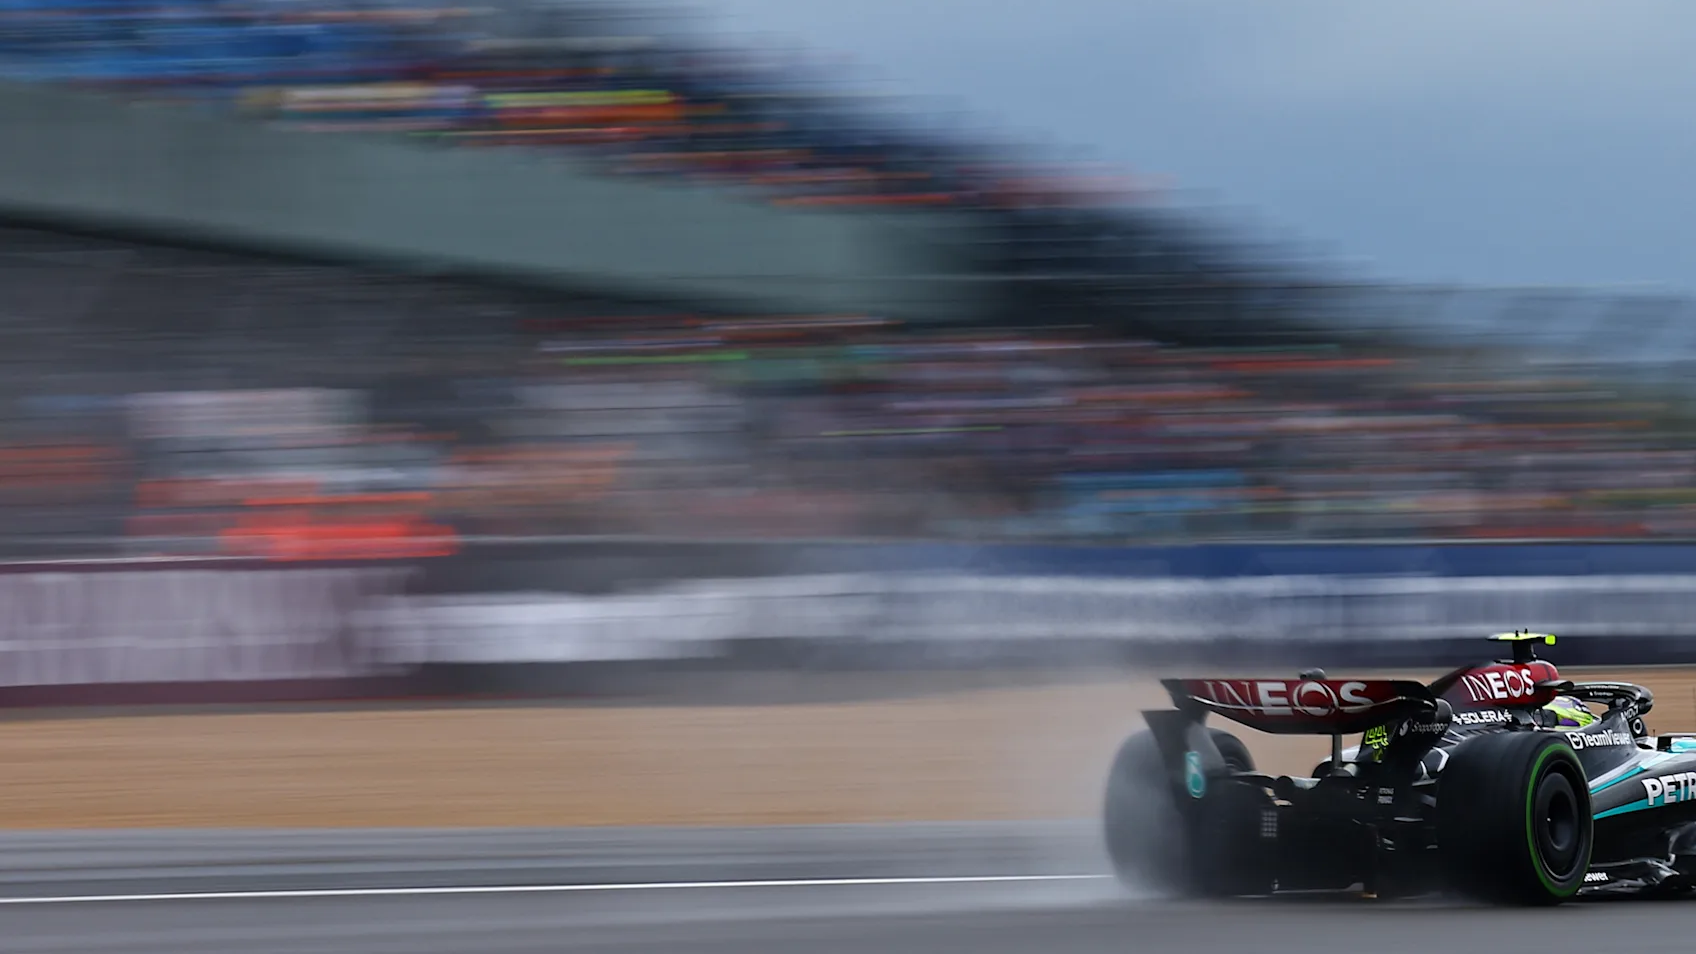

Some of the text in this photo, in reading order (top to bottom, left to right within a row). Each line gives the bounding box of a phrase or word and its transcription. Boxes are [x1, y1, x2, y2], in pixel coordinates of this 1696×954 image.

[1461, 668, 1535, 702] INEOS
[1204, 681, 1374, 716] INEOS
[1461, 710, 1505, 725] SOLERA
[1579, 729, 1631, 747] TeamViewer
